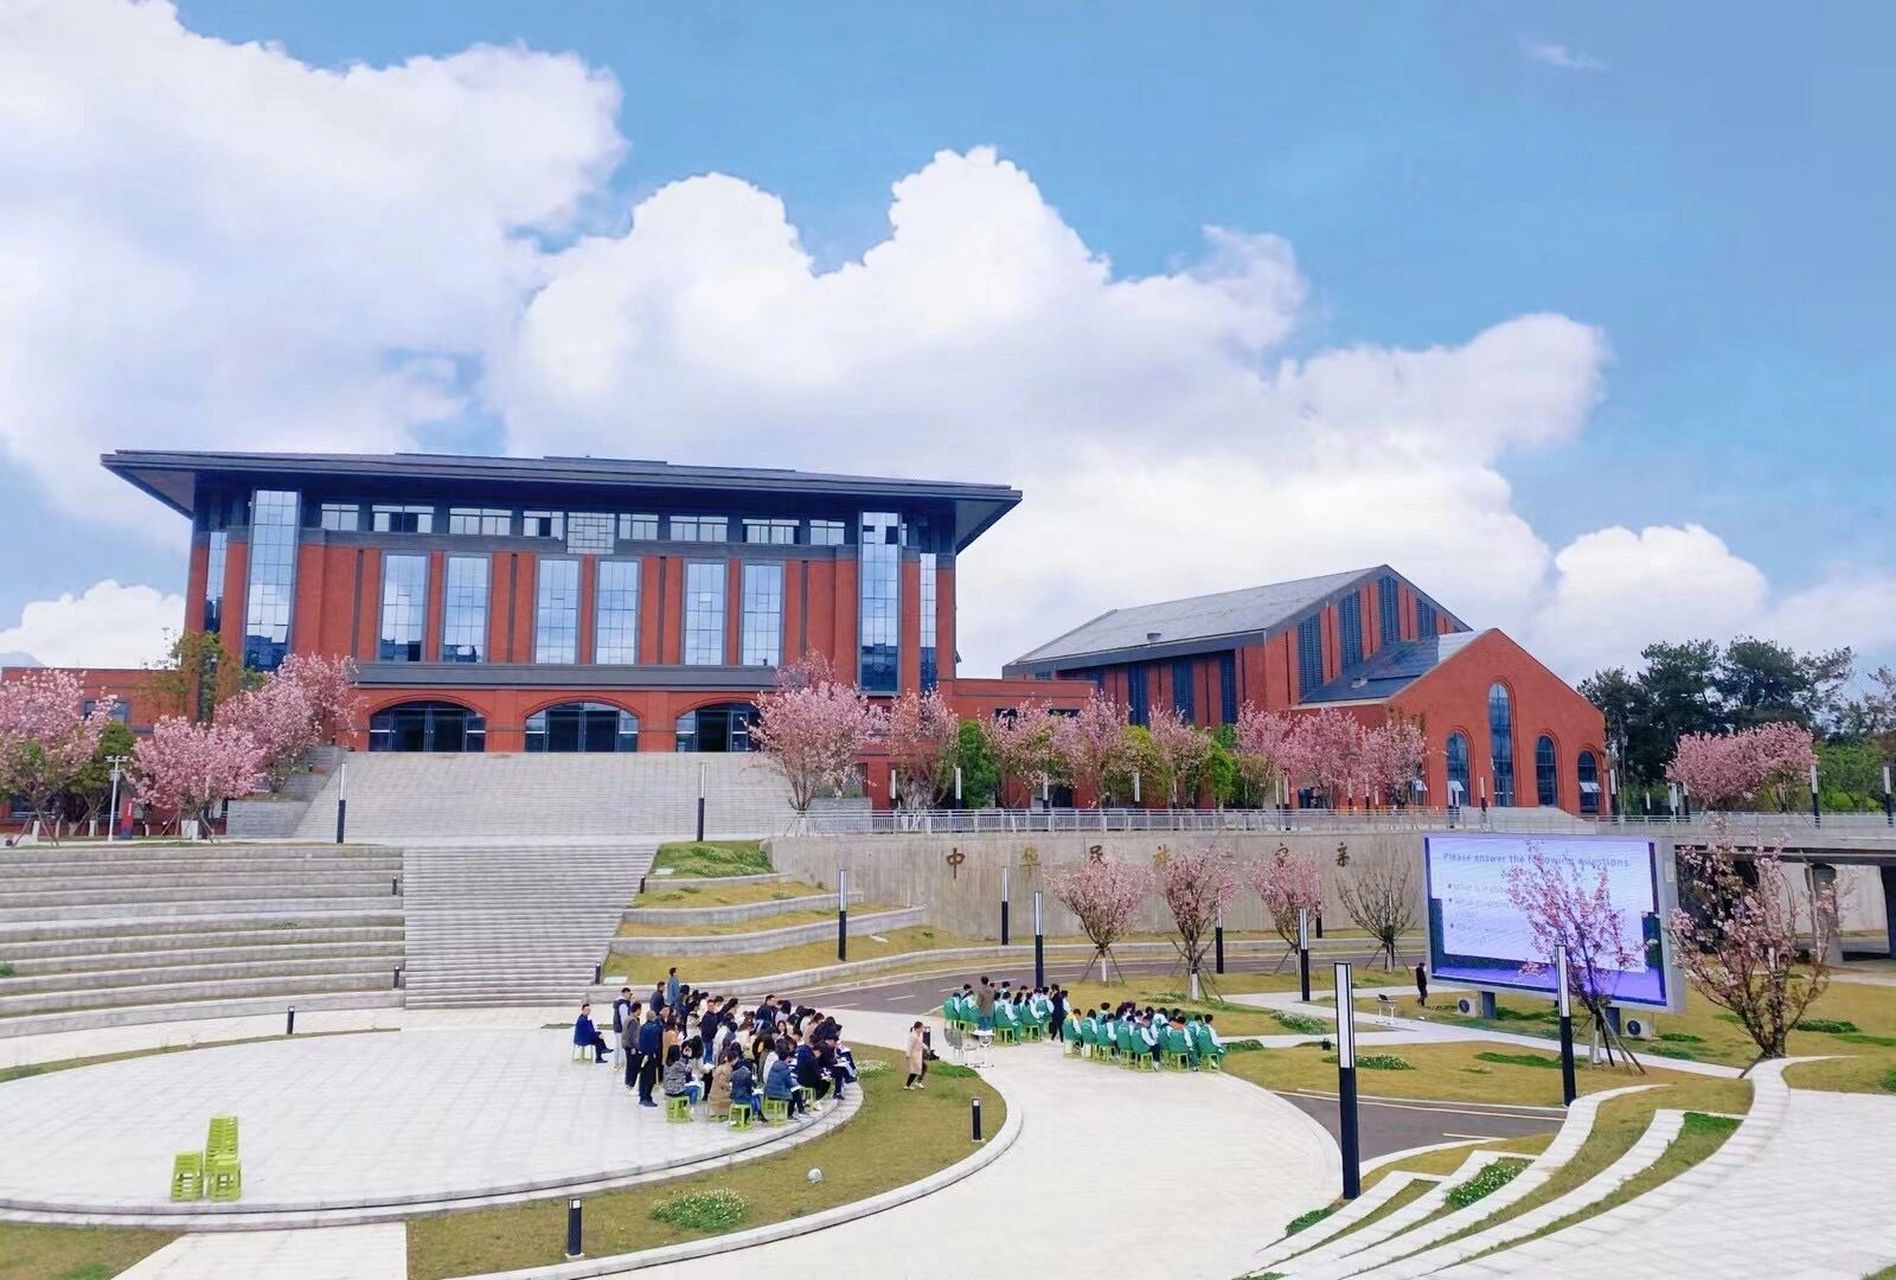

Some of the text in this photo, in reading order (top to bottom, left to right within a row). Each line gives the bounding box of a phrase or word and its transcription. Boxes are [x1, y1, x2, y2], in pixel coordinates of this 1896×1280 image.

[1443, 853, 1471, 863] Please
[1474, 854, 1506, 863] answer
[1509, 854, 1525, 864] the
